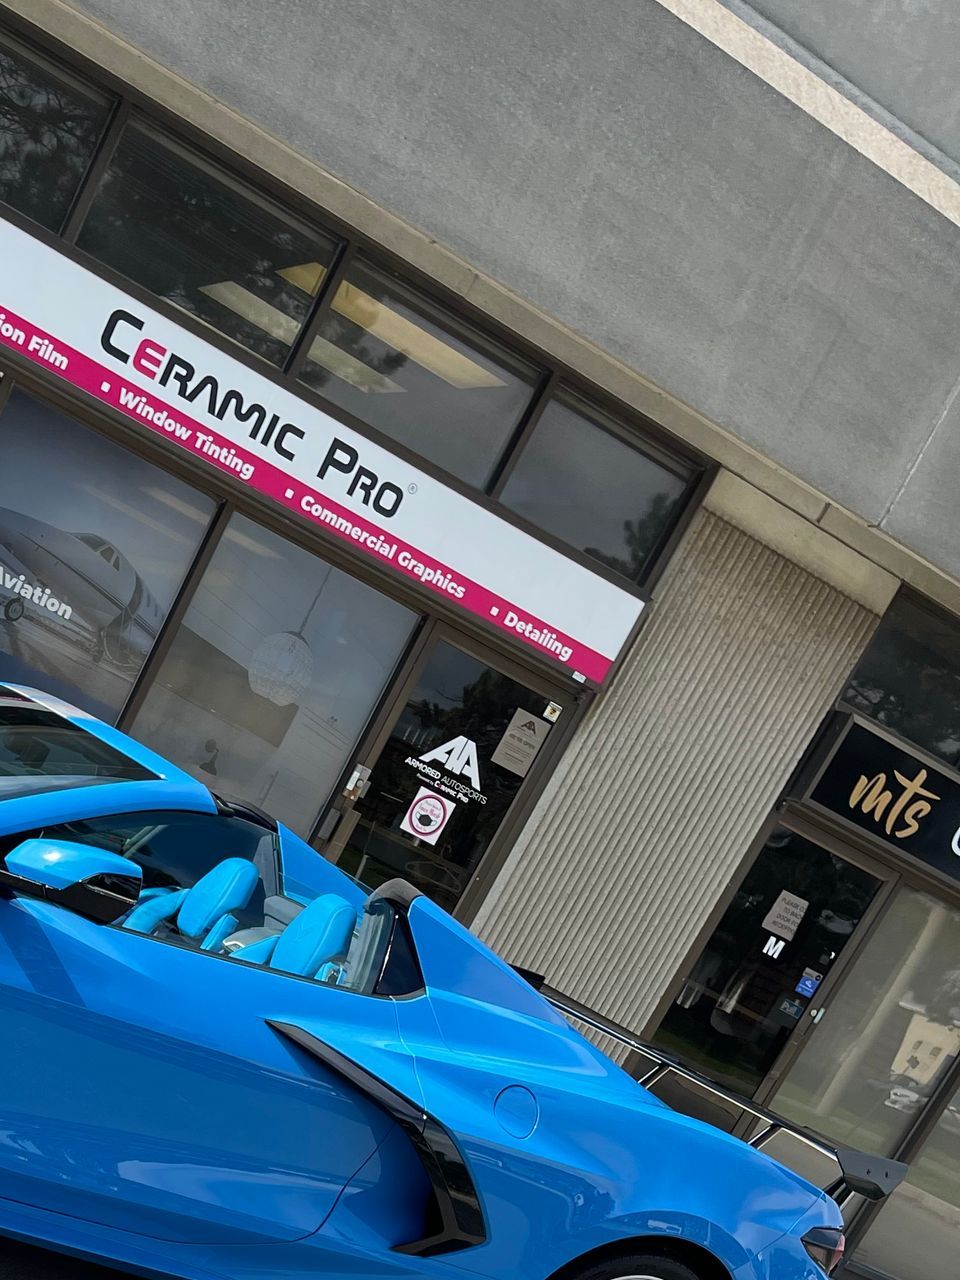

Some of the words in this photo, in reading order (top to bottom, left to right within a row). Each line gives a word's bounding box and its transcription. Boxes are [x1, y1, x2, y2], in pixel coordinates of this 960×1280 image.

[27, 335, 69, 370] Film
[100, 309, 305, 462] CERAMIC
[316, 437, 404, 518] PRO
[118, 387, 192, 441] Window
[194, 430, 255, 481] Tinting
[300, 495, 397, 559] Commercial
[397, 551, 466, 599] Graphics
[503, 611, 573, 662] Detailing
[404, 756, 441, 780] ARMORED
[441, 775, 488, 805] AUTOSPORTS
[849, 768, 941, 838] mts
[762, 935, 785, 959] M
